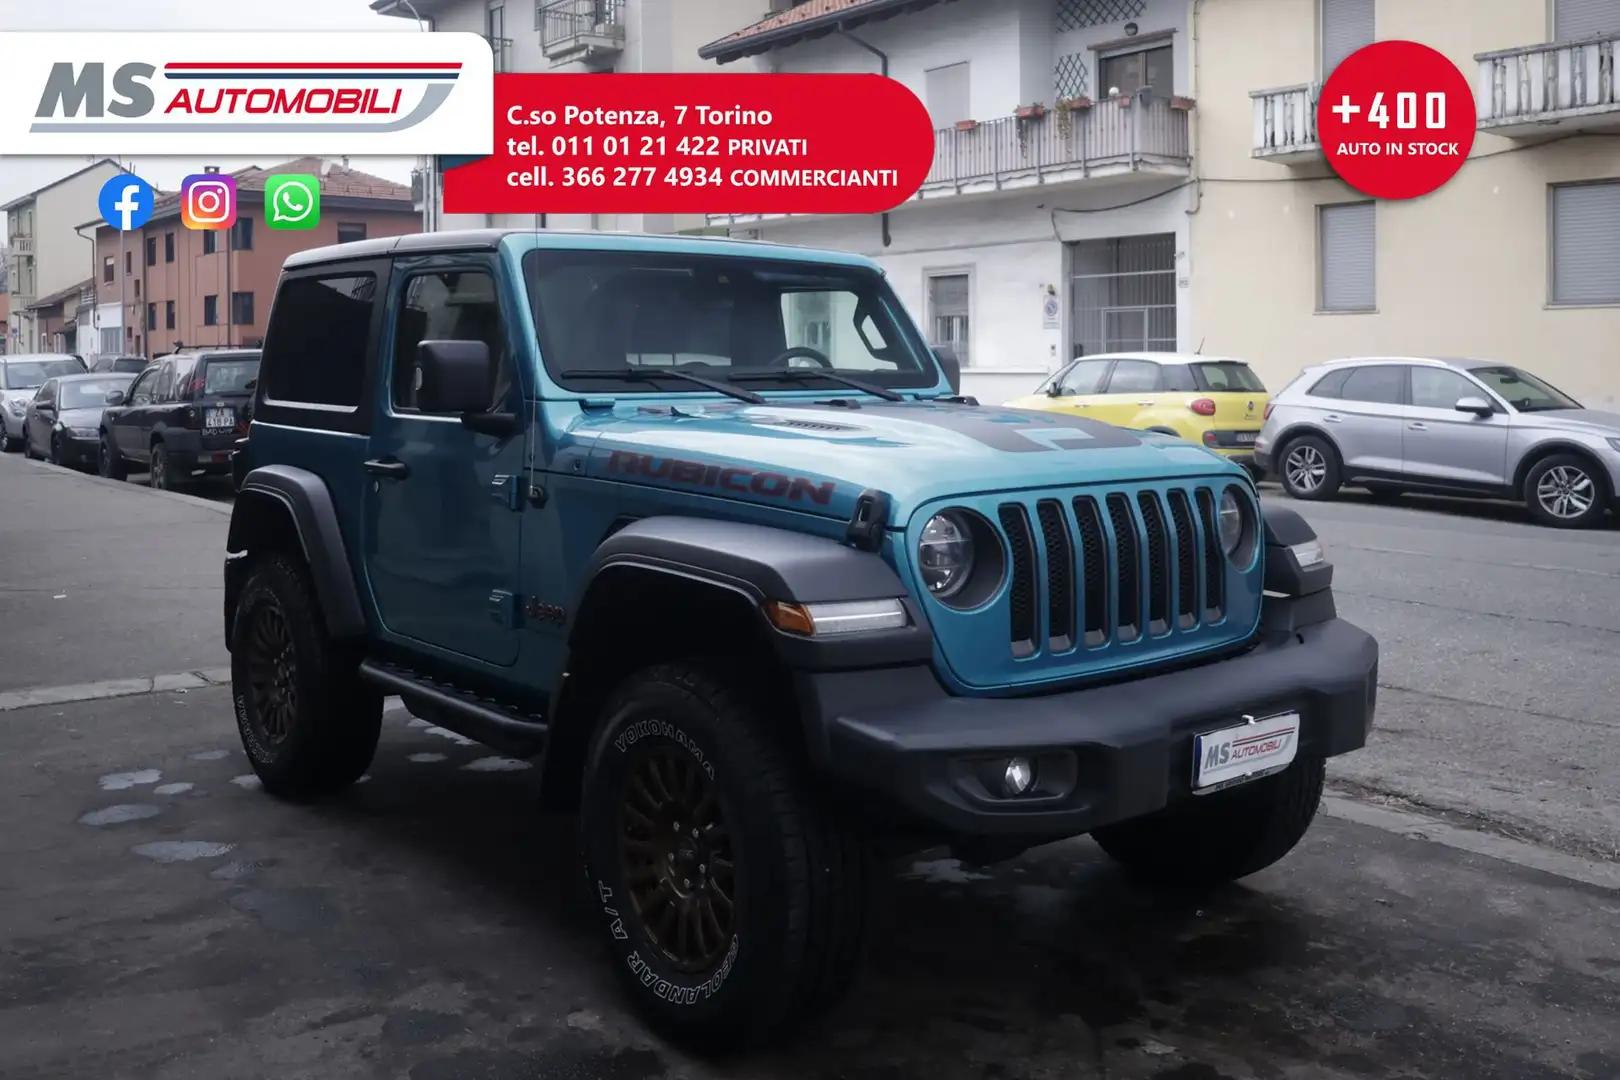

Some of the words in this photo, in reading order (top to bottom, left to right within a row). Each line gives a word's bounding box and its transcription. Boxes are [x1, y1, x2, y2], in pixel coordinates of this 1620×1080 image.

[606, 450, 837, 506] RUBICON
[613, 718, 716, 781] YOKOHAMA
[1203, 741, 1231, 770] MS
[1231, 739, 1282, 760] AUTOMOBILI
